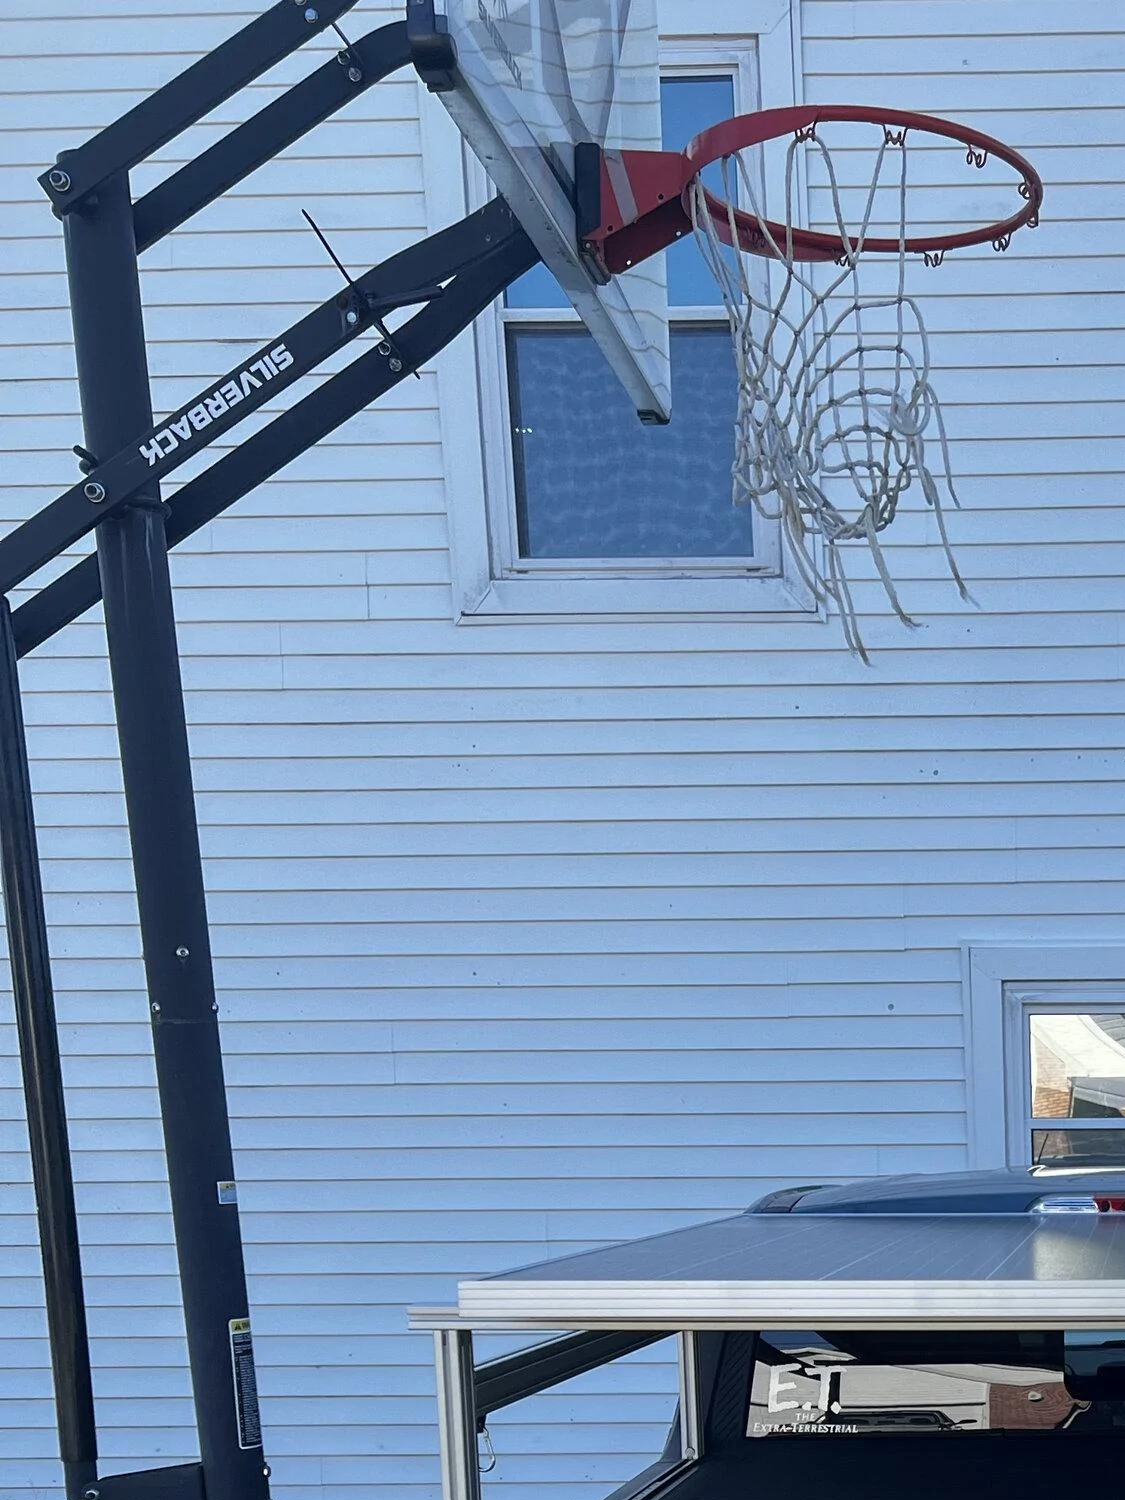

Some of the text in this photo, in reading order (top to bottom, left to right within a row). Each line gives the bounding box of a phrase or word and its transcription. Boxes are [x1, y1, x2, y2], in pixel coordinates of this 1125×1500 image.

[139, 343, 294, 467] SILVERBACK
[768, 1363, 848, 1414] E.T.
[752, 1422, 859, 1434] EXTRA-TERRESTRIAL
[795, 1412, 818, 1422] THE
